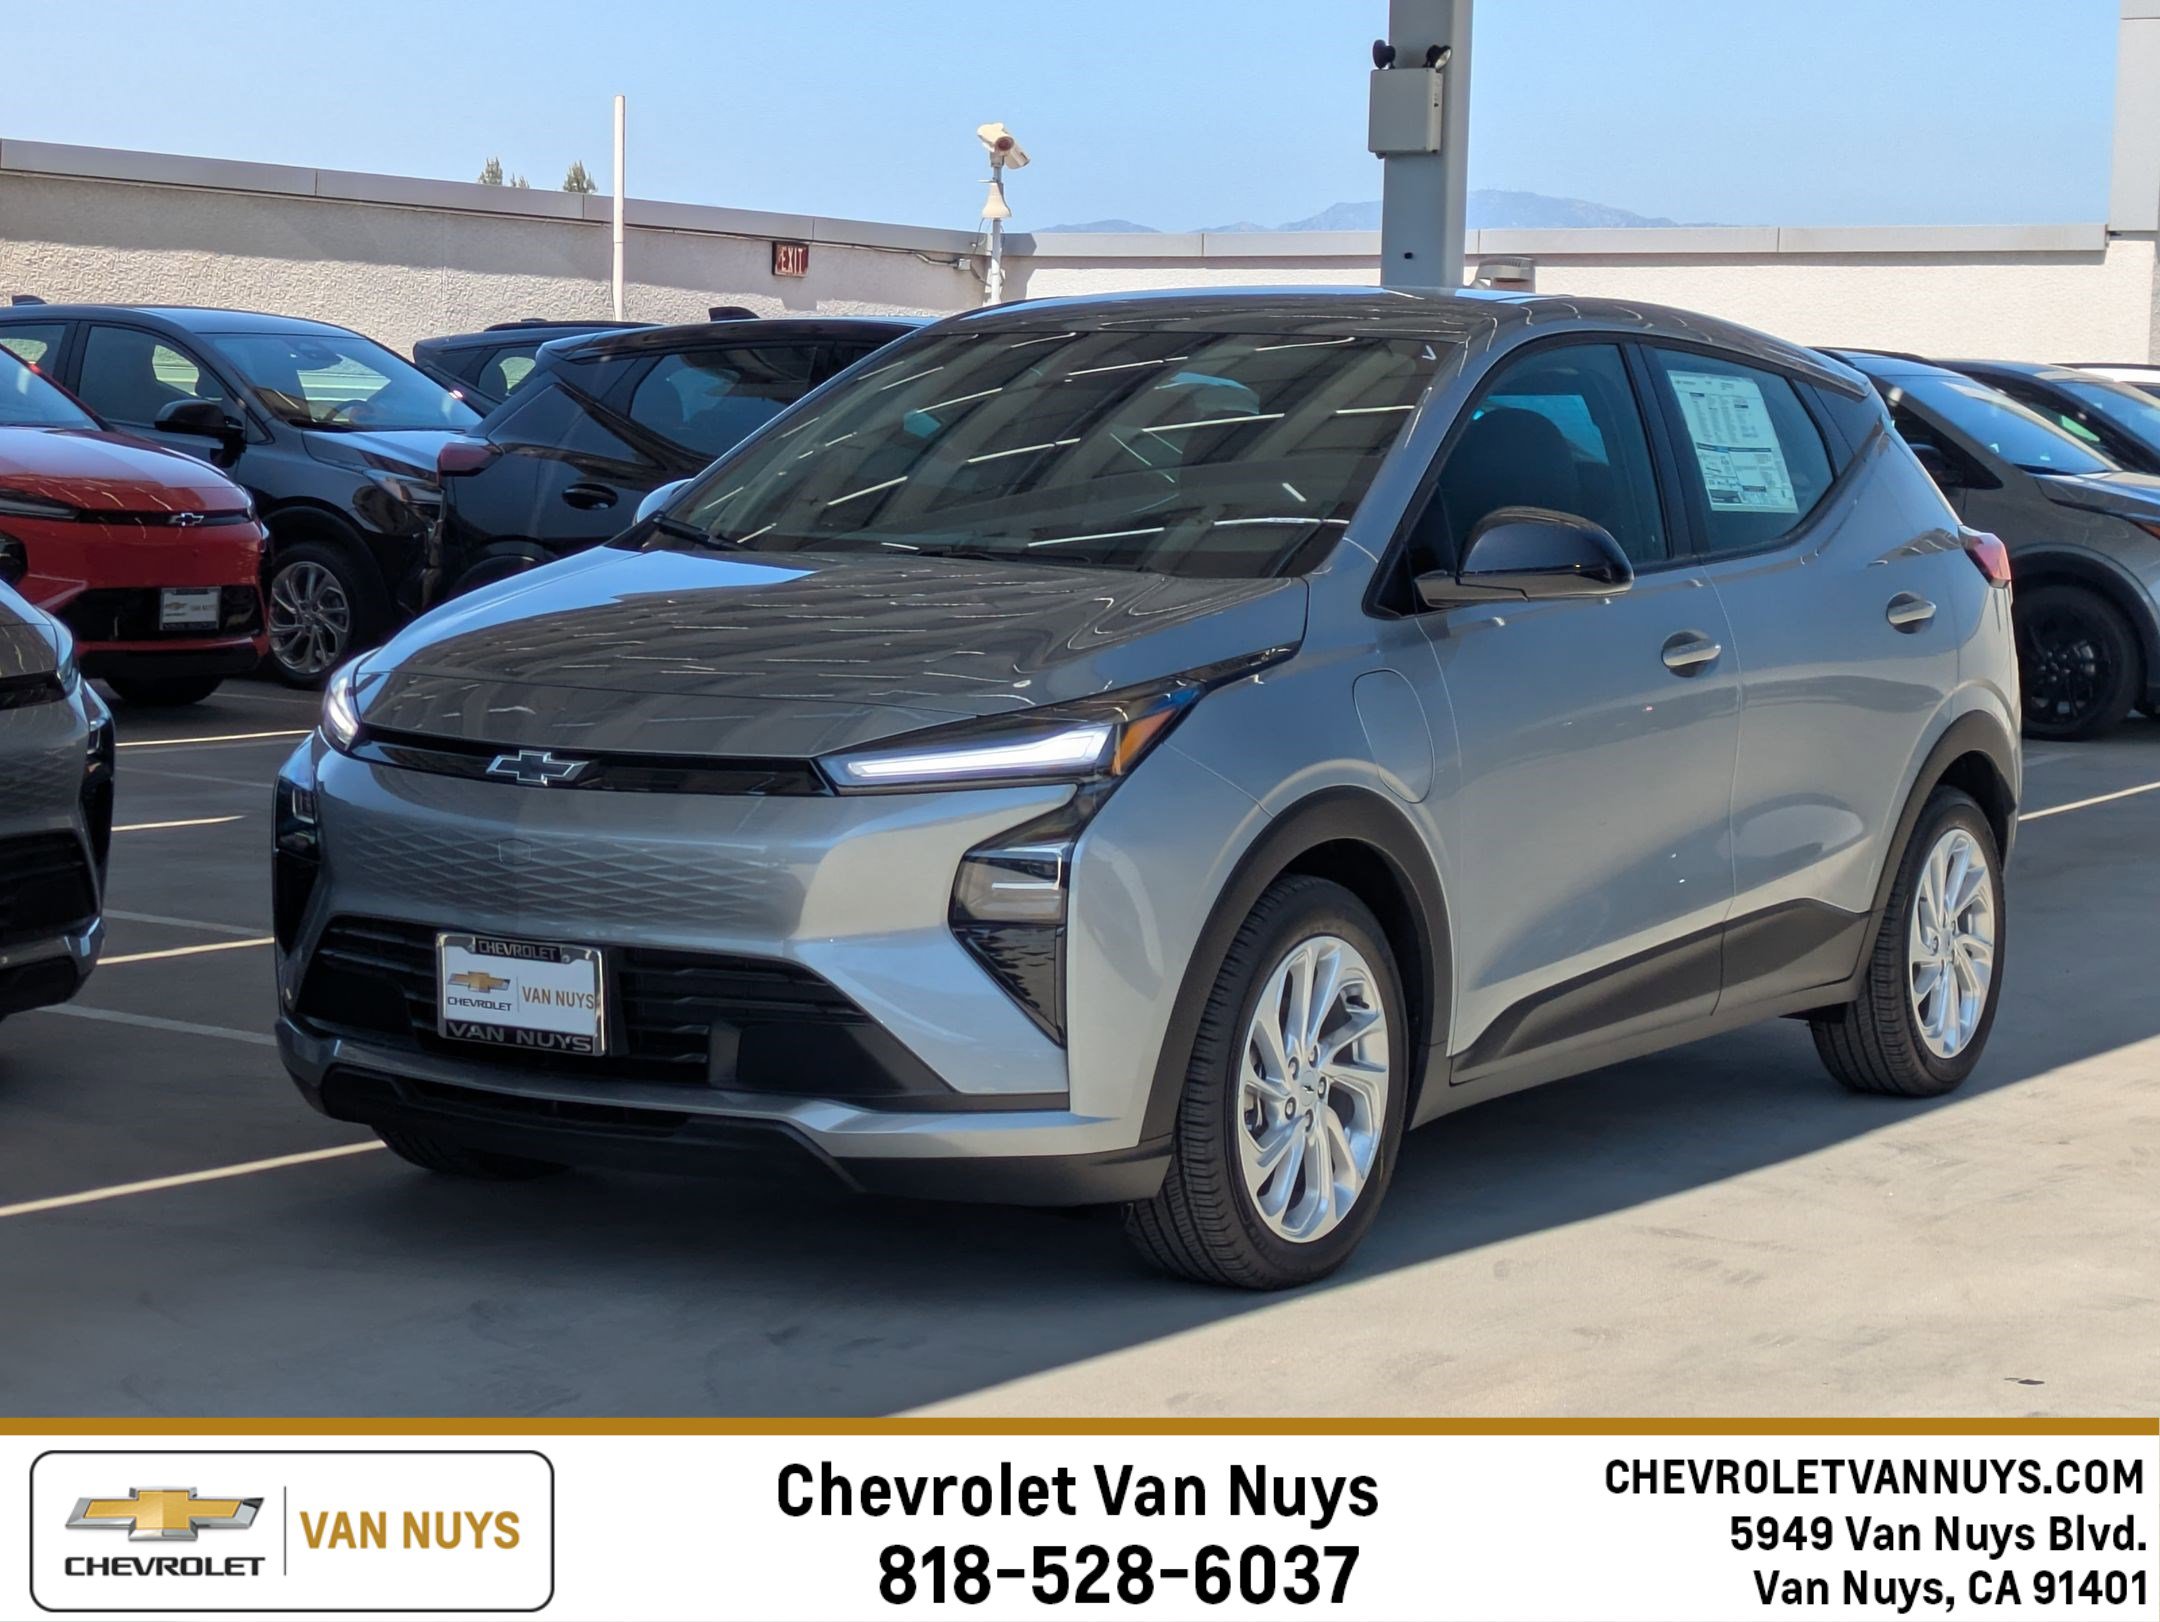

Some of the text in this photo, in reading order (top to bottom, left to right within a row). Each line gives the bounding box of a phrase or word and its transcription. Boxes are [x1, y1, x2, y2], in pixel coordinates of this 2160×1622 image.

[781, 246, 804, 275] EXIT
[478, 940, 558, 961] CHEVROLET
[447, 996, 512, 1012] CHEVROLET
[522, 986, 595, 1010] VAN NUYS
[448, 1021, 592, 1053] VAN NUYS
